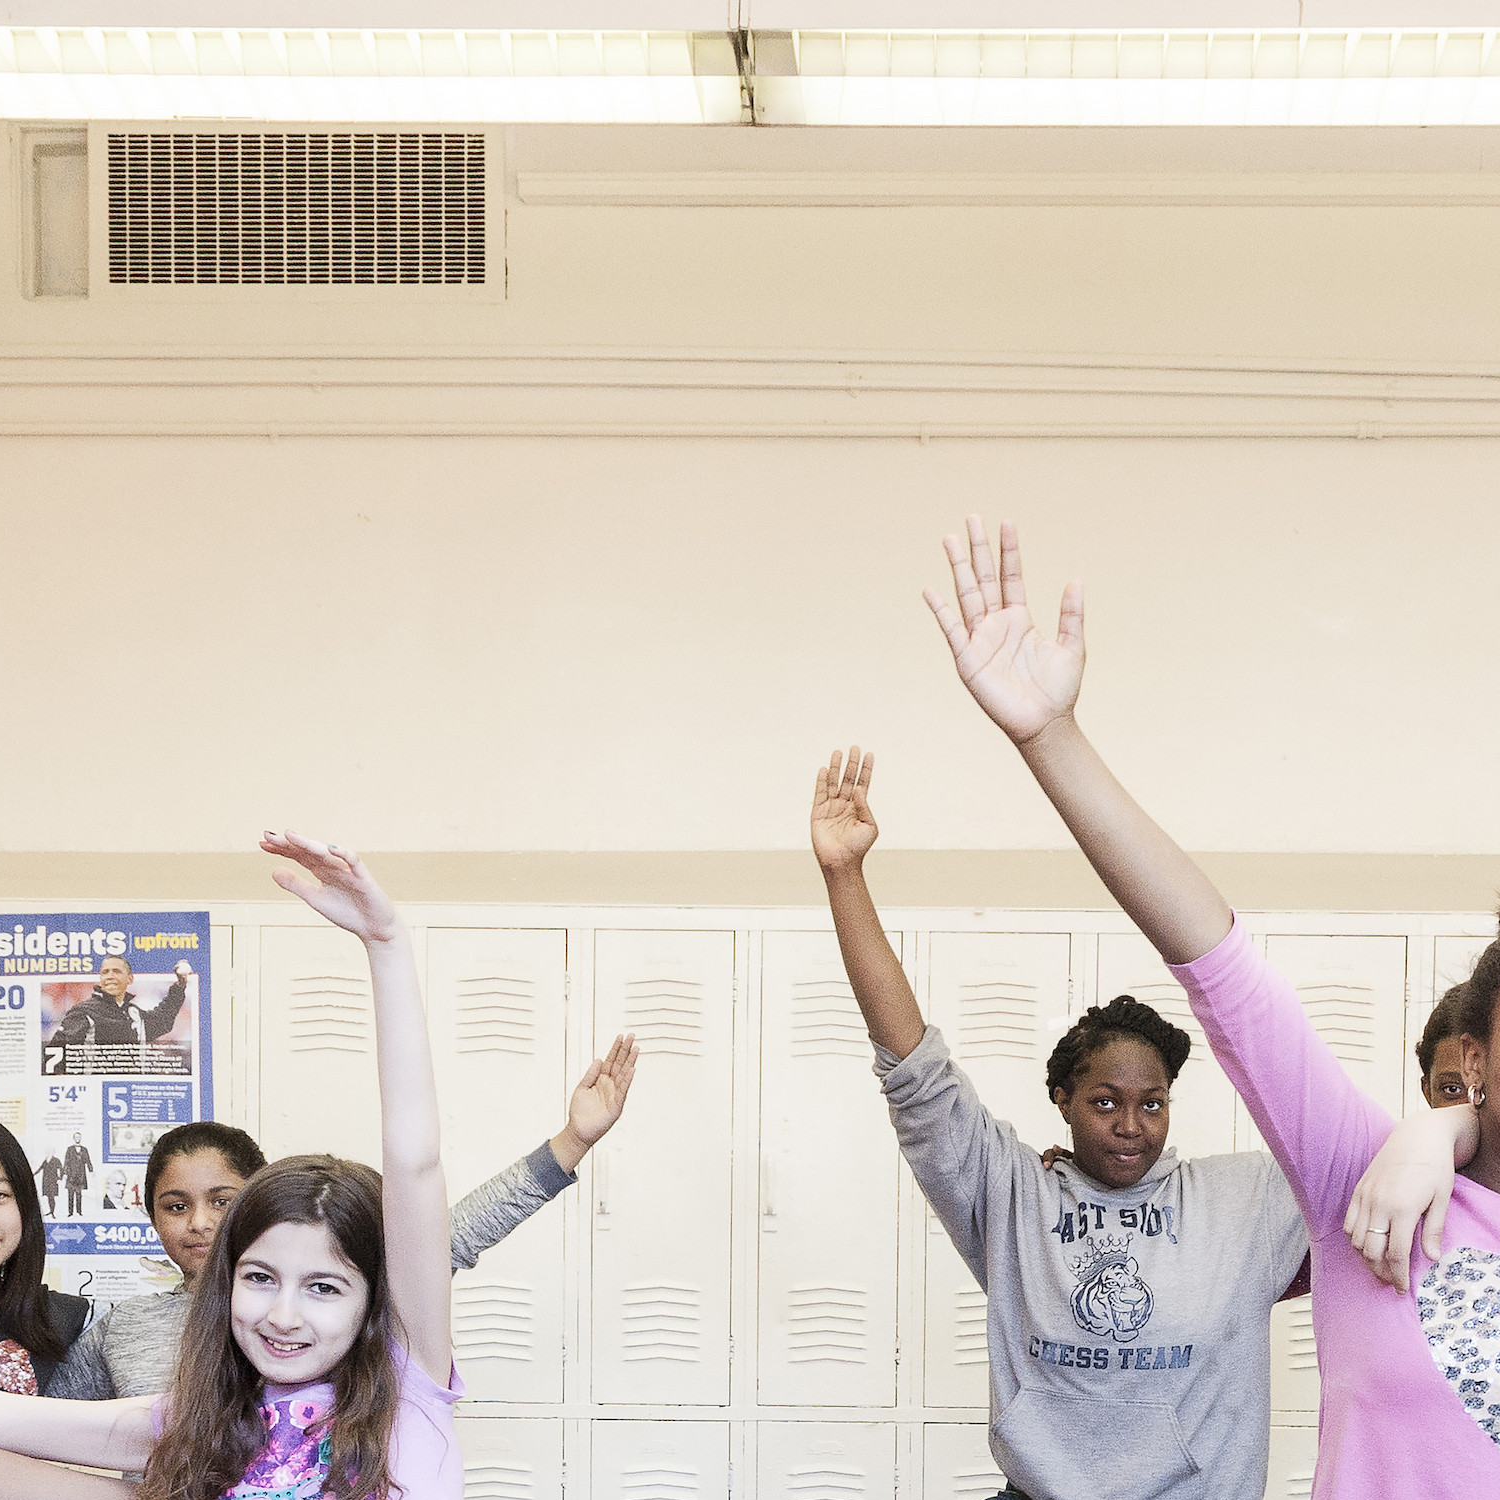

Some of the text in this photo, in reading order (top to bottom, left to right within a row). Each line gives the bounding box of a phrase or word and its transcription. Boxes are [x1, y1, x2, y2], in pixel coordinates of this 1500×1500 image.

[134, 931, 200, 953] upfront
[3, 956, 94, 974] NUMBERS
[44, 1046, 64, 1074] 7
[107, 1086, 128, 1119] 5
[94, 1225, 161, 1244] $400,0
[78, 1270, 93, 1297] 2
[1029, 1335, 1194, 1371] CHESS TEAM
